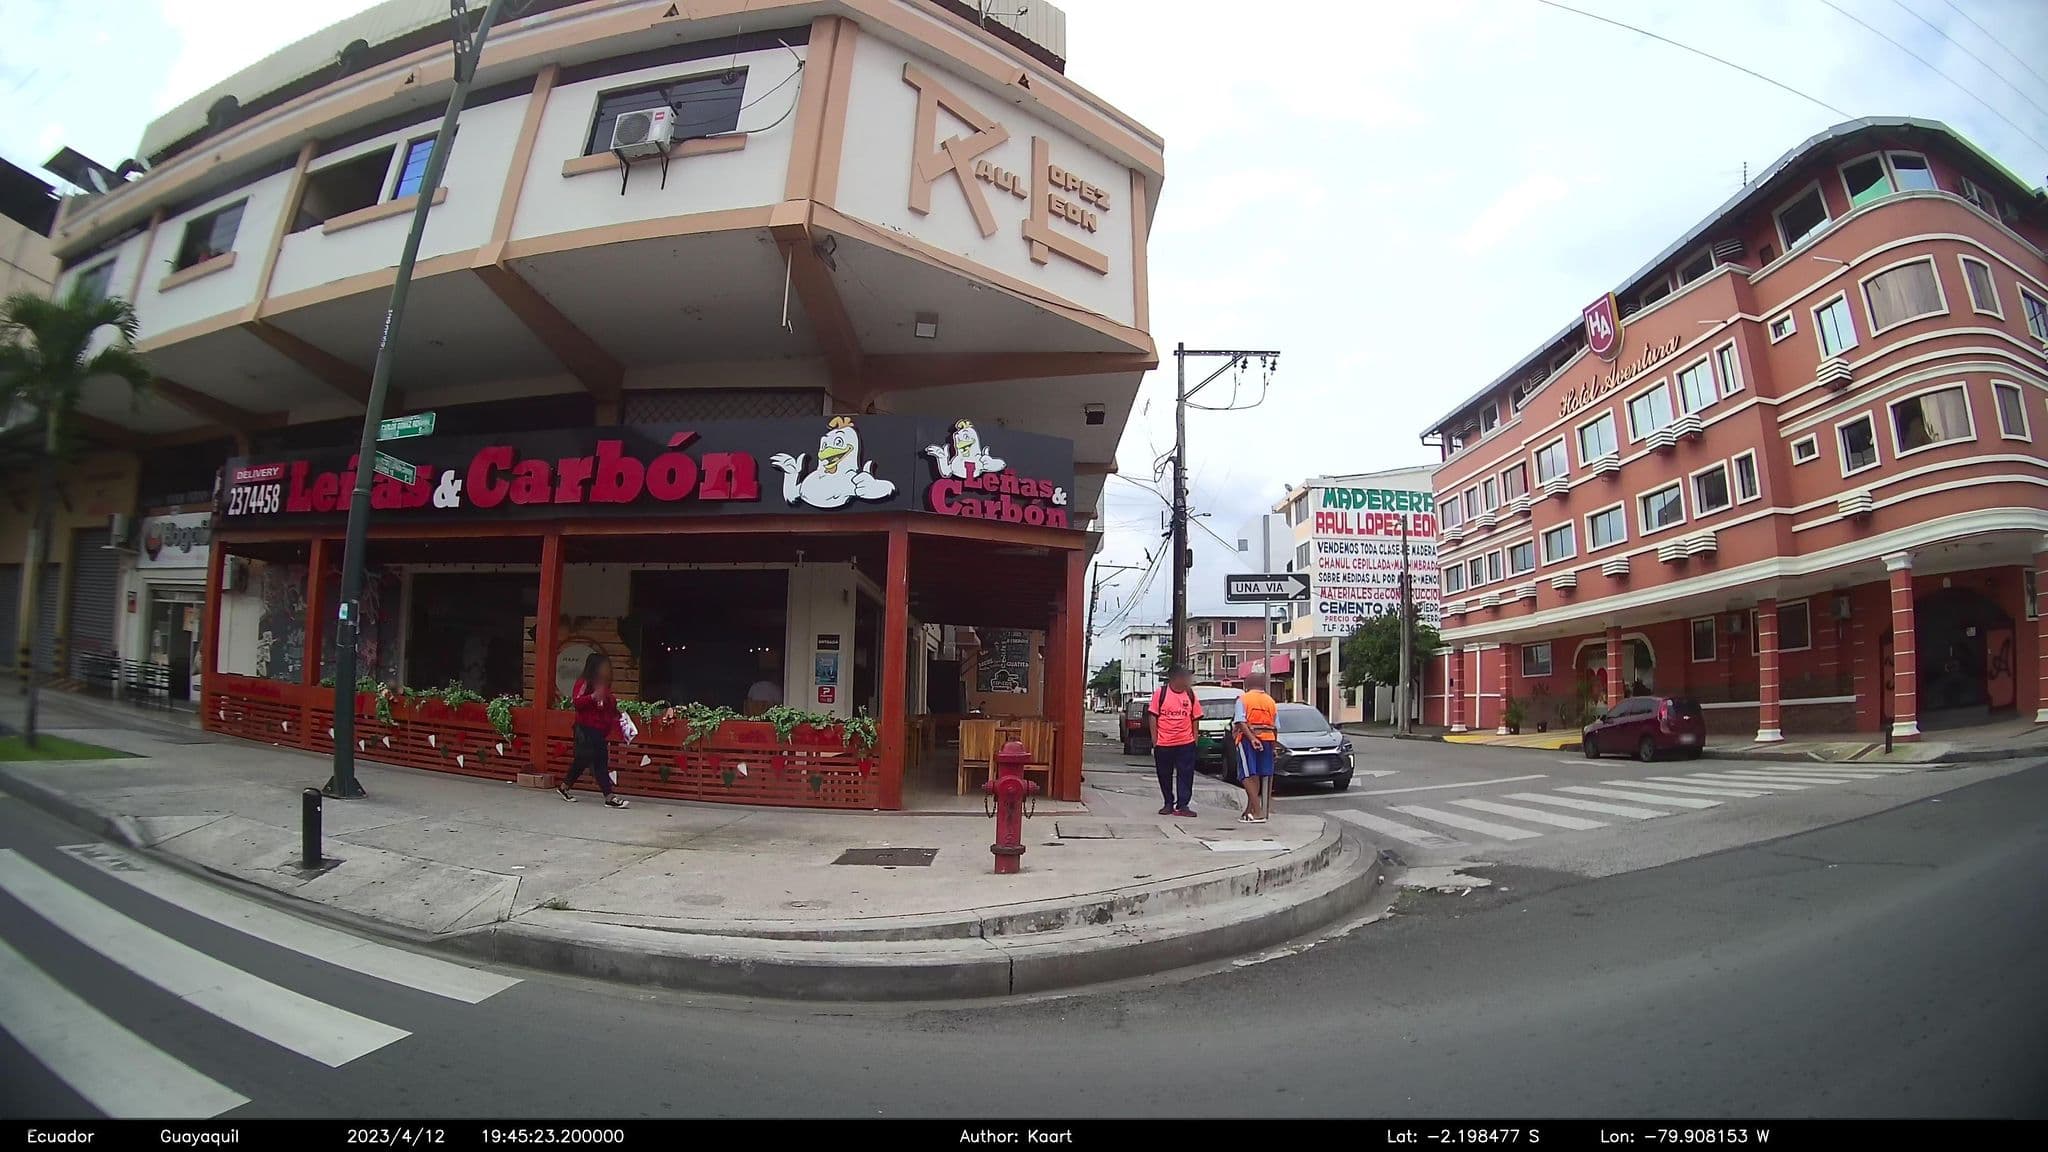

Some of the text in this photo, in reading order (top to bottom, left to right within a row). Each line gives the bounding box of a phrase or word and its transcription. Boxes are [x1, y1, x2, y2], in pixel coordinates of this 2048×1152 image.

[1588, 310, 1612, 339] HA
[1559, 336, 1681, 417] Hotel Aventura
[236, 467, 280, 480] DELIVERY
[433, 470, 462, 508] &
[467, 432, 760, 508] Carbón
[964, 461, 1067, 505] Leñas &
[228, 484, 280, 515] 2374458
[930, 478, 1069, 529] Carbón
[1357, 513, 1402, 537] LOPEZ
[1317, 542, 1359, 555] VENDEMOS
[1361, 543, 1378, 555] TODA
[1380, 544, 1400, 556] CLASE
[1318, 557, 1350, 570] CHANUL
[1352, 558, 1391, 570] CEPILLADA
[1318, 572, 1341, 583] SOBRE
[1342, 573, 1371, 584] MEDIDAS
[1371, 573, 1381, 584] AL
[1382, 574, 1396, 584] POR
[1236, 583, 1284, 593] UNA VIA
[1320, 587, 1373, 600] MATERIALES
[1374, 588, 1384, 600] de
[1319, 602, 1382, 614] CEMENTO
[1325, 615, 1350, 623] PRECIO
[1322, 624, 1337, 632] TLF
